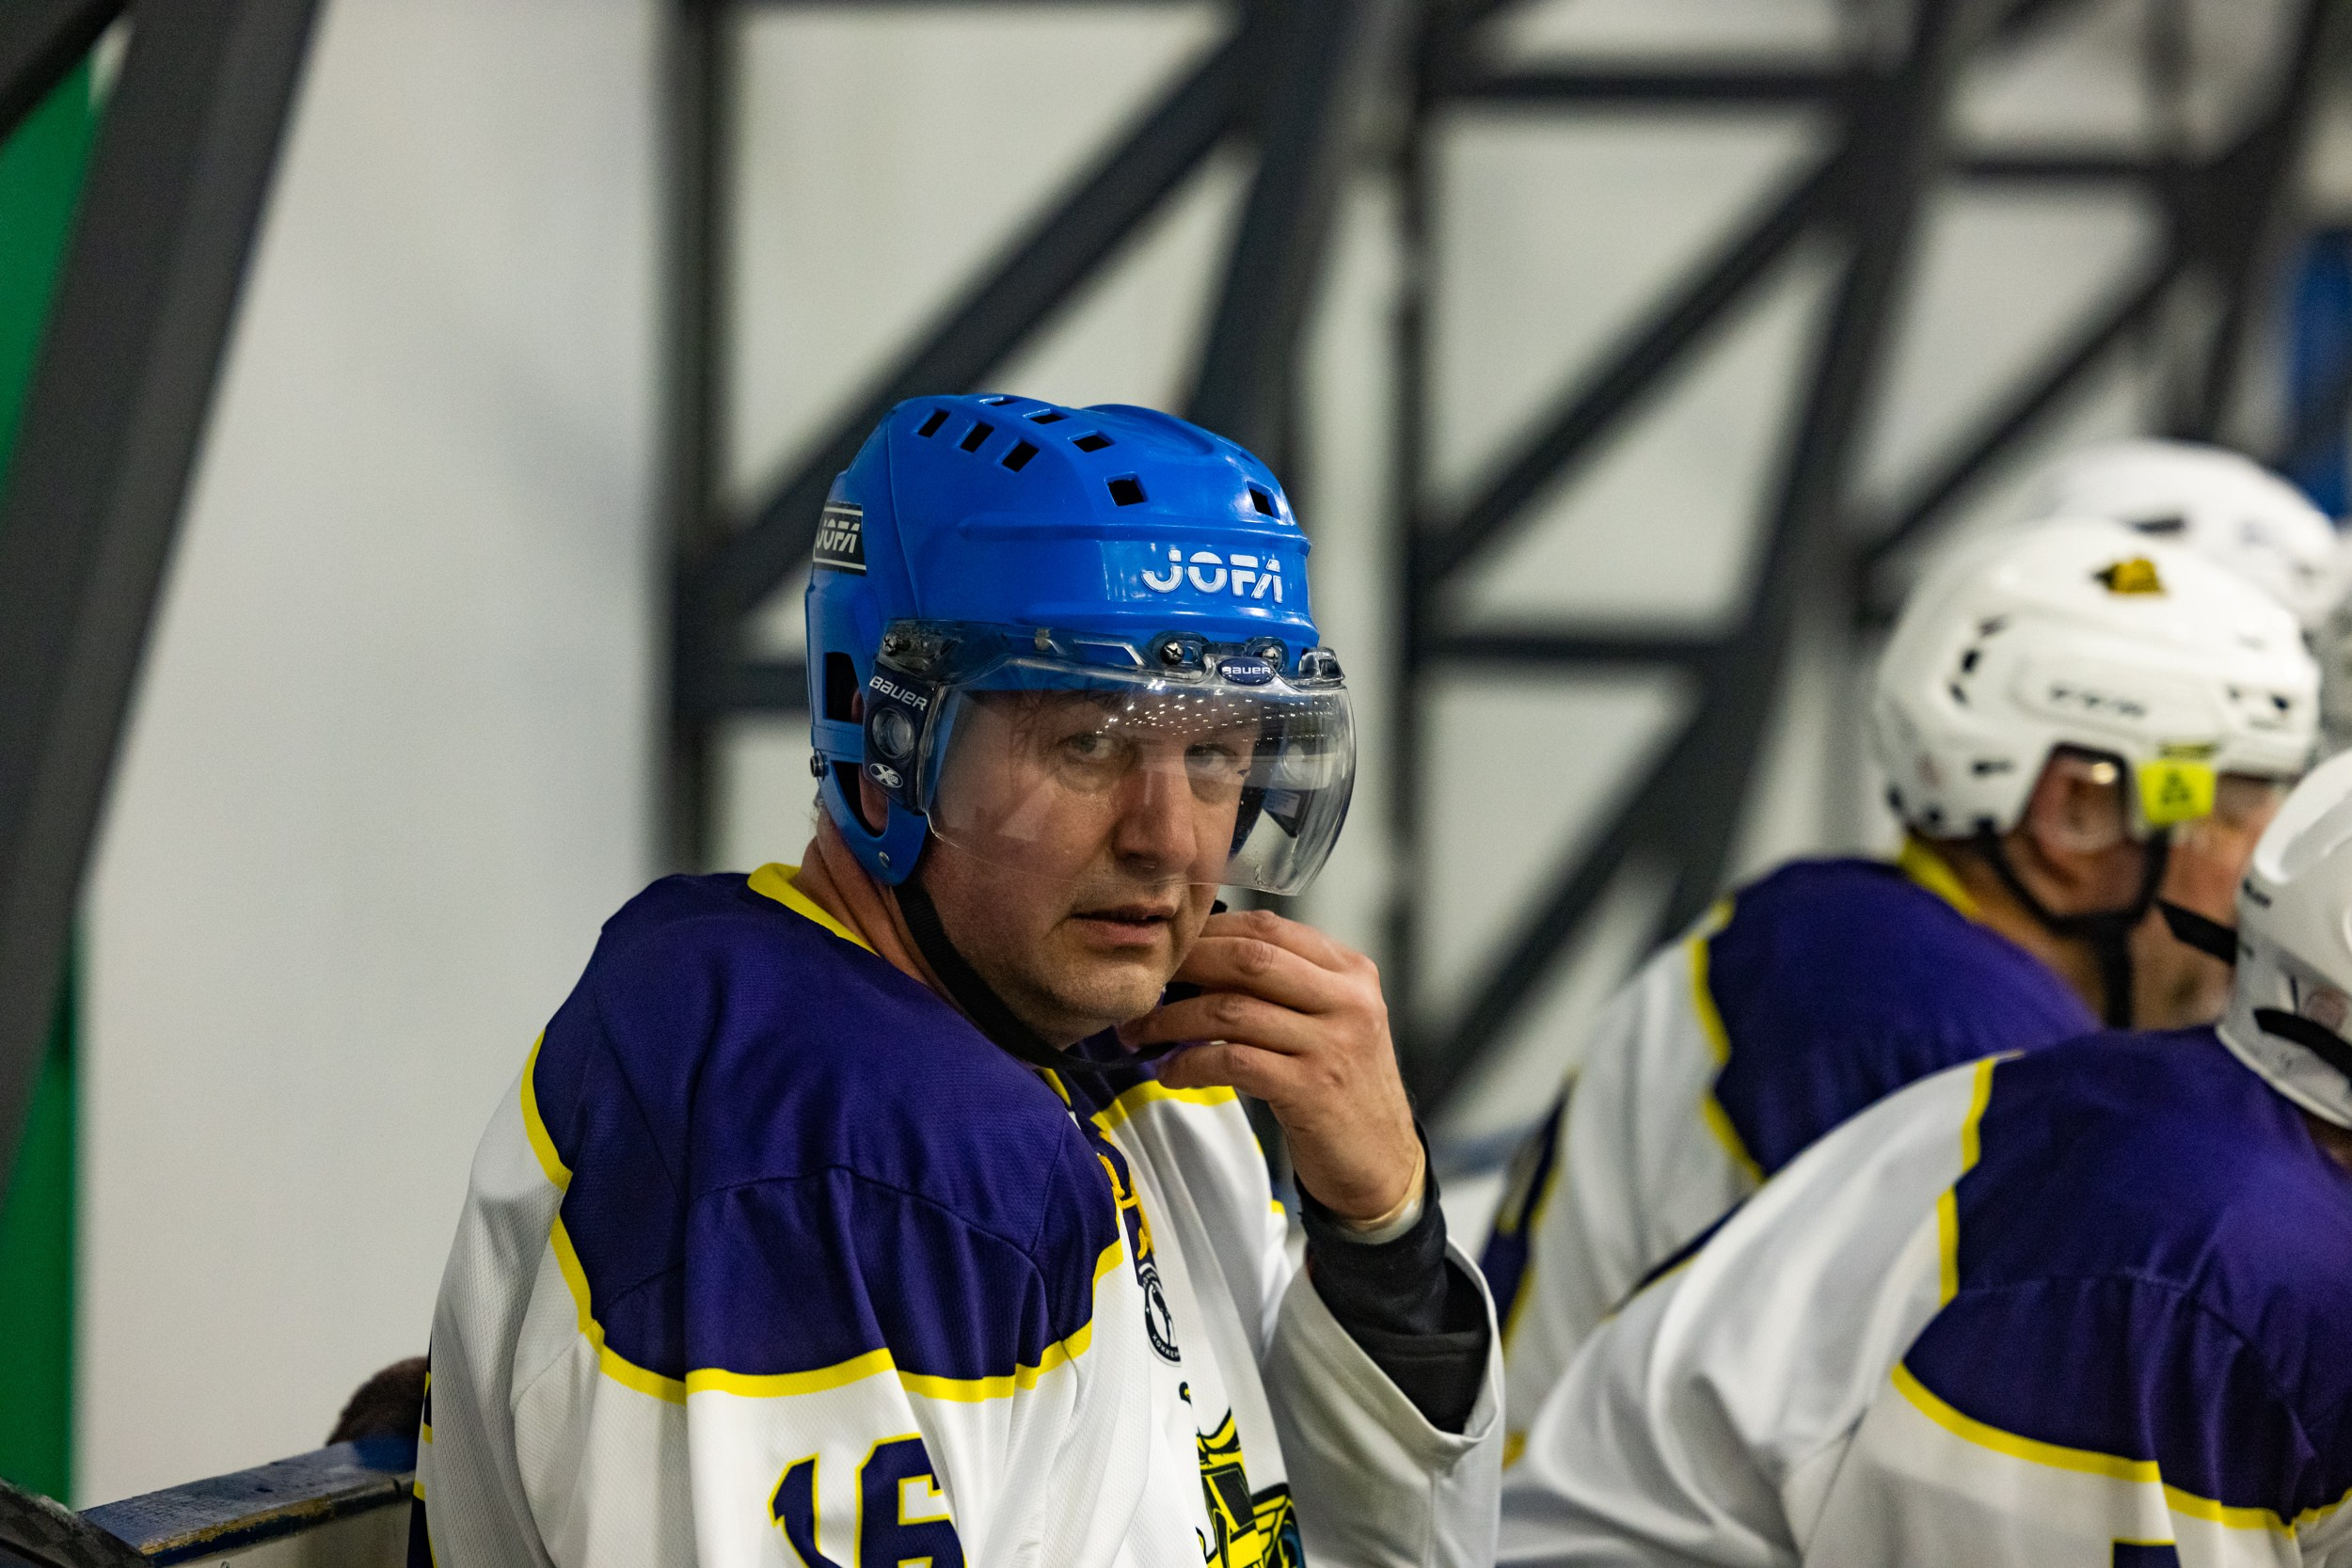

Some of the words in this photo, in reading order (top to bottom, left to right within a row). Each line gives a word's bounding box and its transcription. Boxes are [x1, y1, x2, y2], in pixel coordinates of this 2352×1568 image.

[1140, 549, 1283, 603] JOFA
[868, 675, 929, 711] BAUER
[767, 1432, 968, 1568] 16
